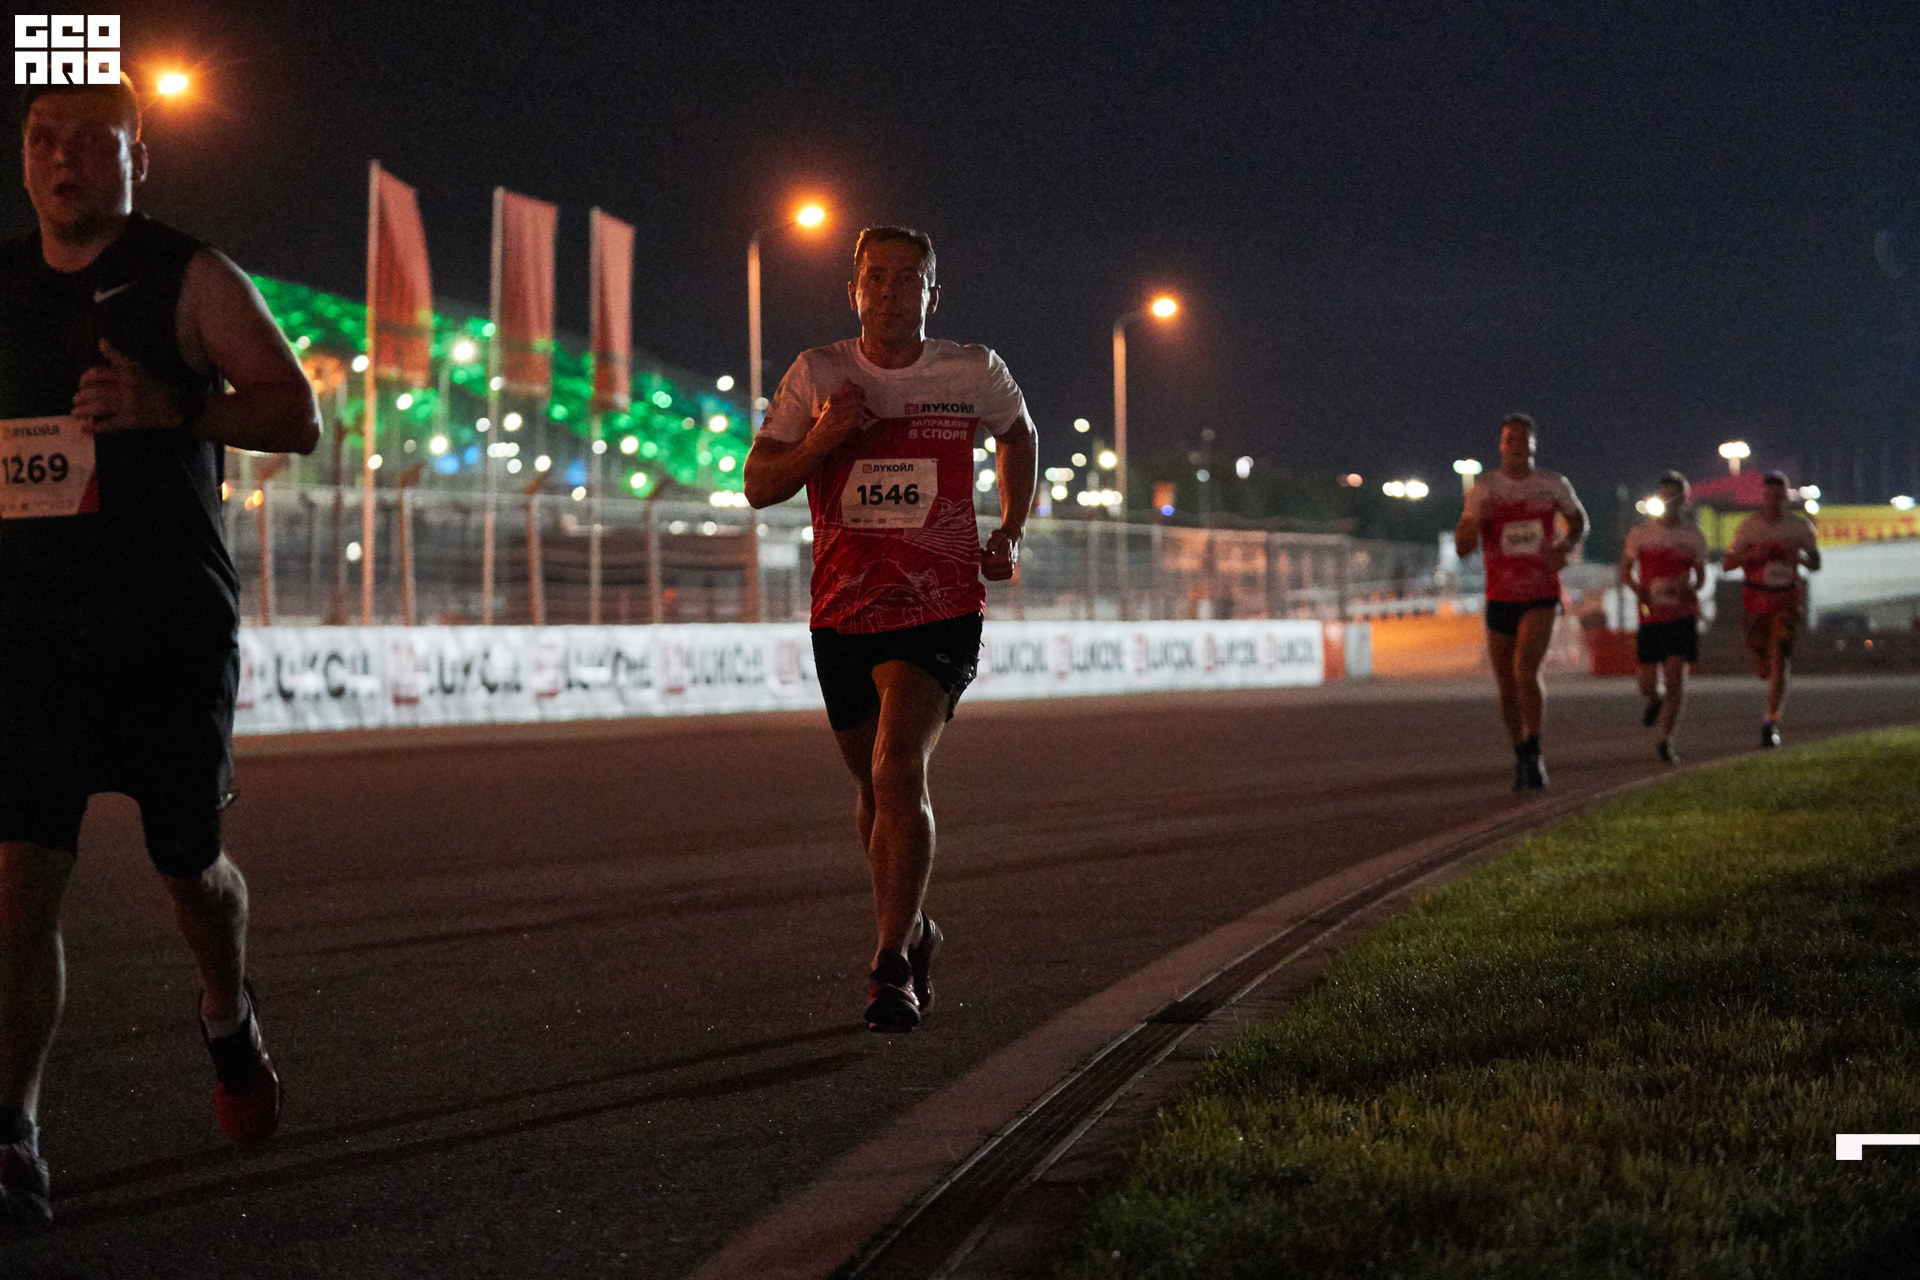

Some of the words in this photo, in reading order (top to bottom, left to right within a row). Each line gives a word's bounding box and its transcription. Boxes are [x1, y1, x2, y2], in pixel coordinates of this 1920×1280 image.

[921, 403, 975, 414] ЛУКОЙЛ
[908, 429, 918, 439] В
[1, 452, 69, 485] 1269
[872, 463, 914, 473] ЛУКОЙЛ
[856, 483, 920, 506] 1546
